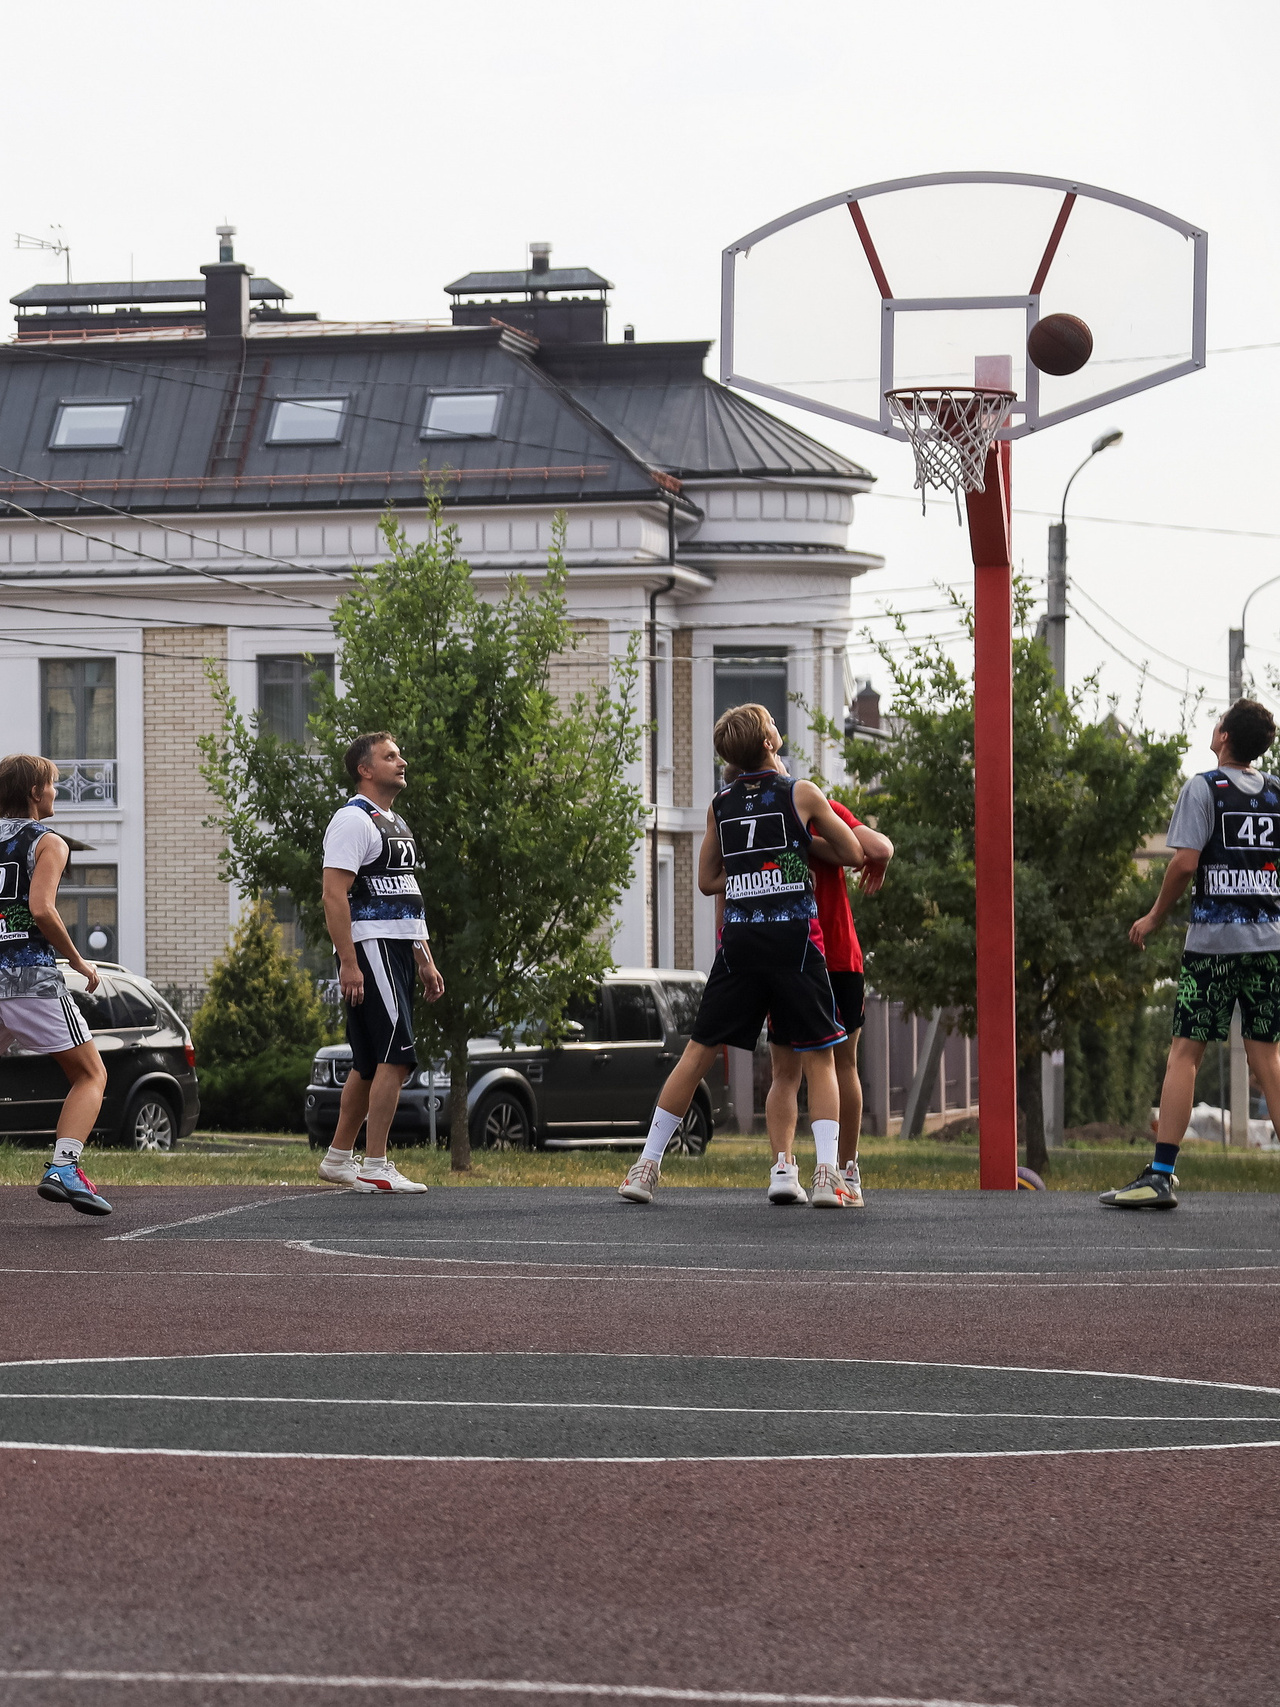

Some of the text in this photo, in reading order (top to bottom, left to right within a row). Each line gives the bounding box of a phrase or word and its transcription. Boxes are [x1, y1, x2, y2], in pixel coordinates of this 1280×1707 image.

[740, 819, 757, 849] 7
[1237, 816, 1274, 846] 42
[397, 841, 415, 866] 21
[726, 869, 783, 893] ТАПОВО
[772, 884, 804, 893] Москва
